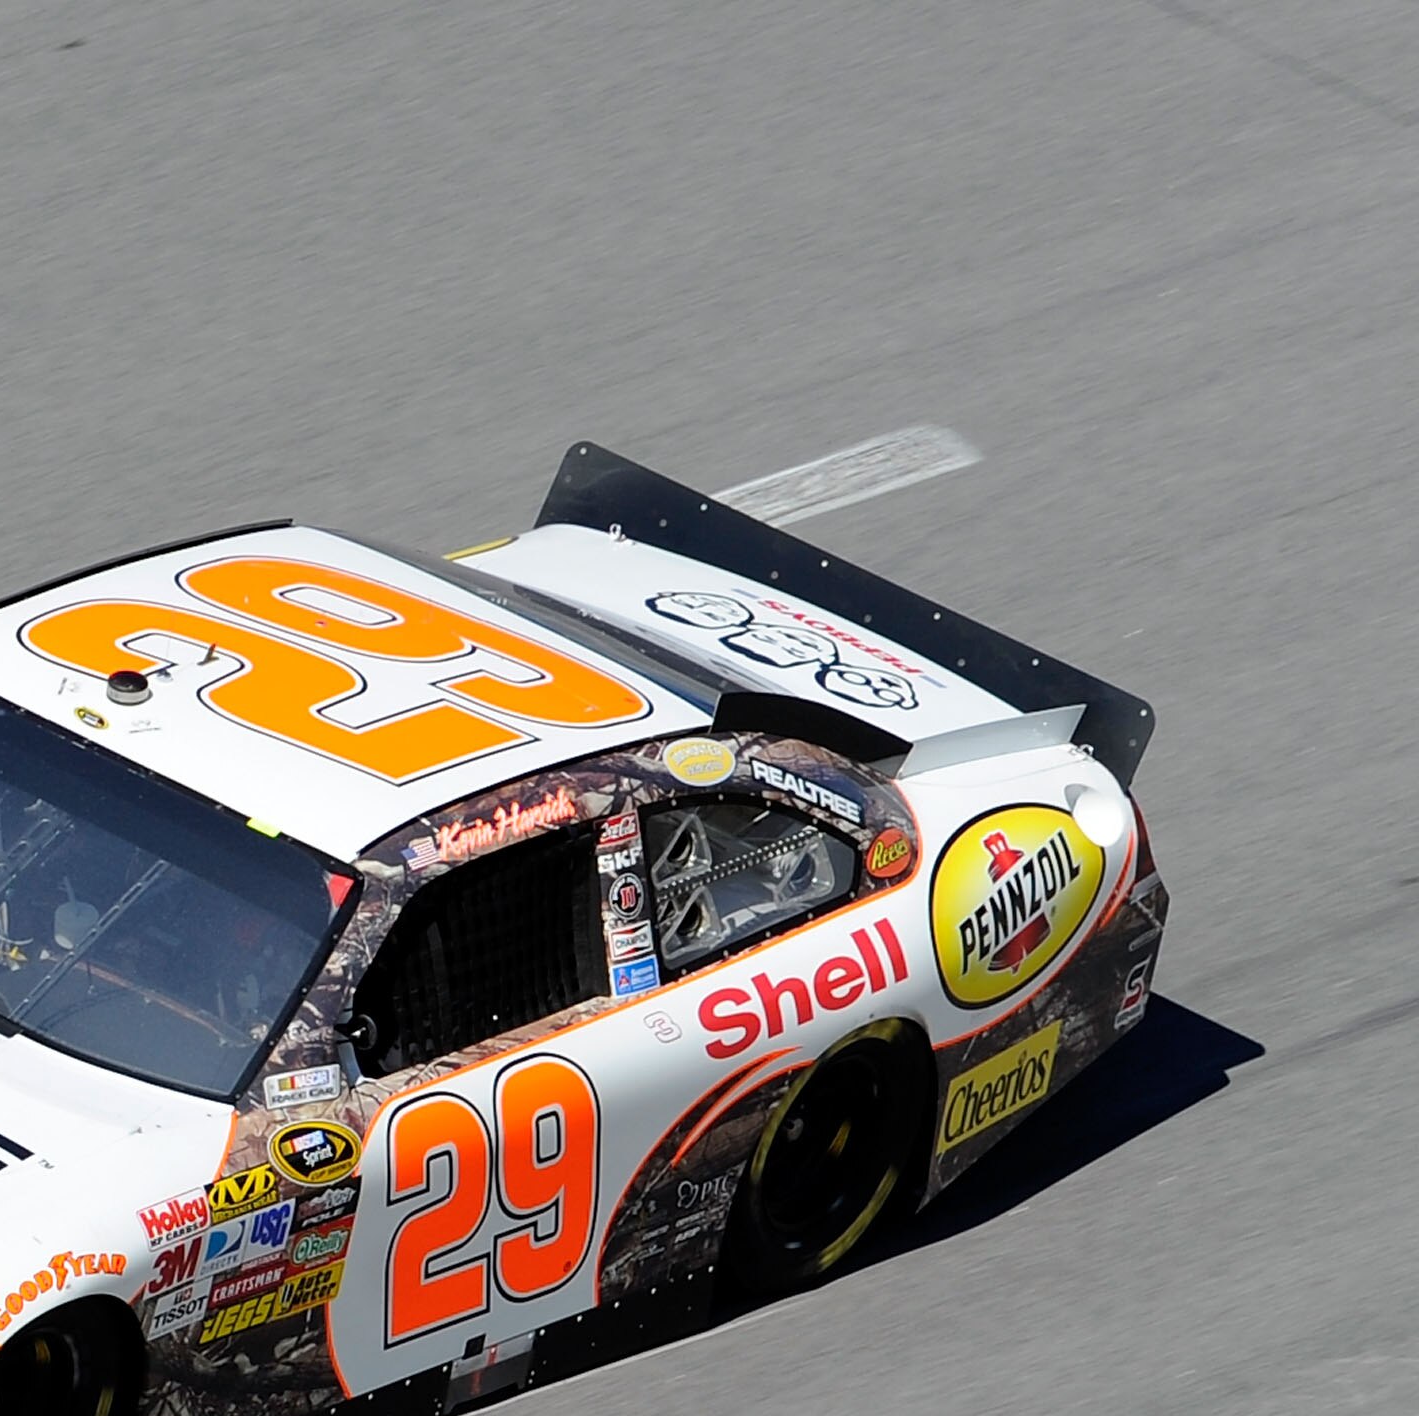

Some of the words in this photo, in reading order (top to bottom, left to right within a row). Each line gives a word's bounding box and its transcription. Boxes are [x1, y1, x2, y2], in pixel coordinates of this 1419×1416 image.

[17, 556, 655, 785] 29
[752, 760, 861, 823] REALTREE
[437, 818, 496, 861] Kevin
[494, 787, 577, 842] Harvick
[597, 848, 643, 873] SKF
[959, 830, 1084, 975] PENNZOIL
[698, 918, 909, 1060] Shell
[643, 1011, 682, 1043] 3
[309, 1086, 334, 1098] CAR
[943, 1049, 1050, 1144] Cheerios
[303, 1144, 334, 1167] Sprint
[140, 1197, 207, 1240] Holley
[250, 1203, 291, 1248] USG
[385, 1053, 601, 1350] 29
[148, 1236, 203, 1294] 3M
[213, 1266, 285, 1302] CRAFTSMAN
[297, 1270, 332, 1292] Auto
[153, 1295, 208, 1329] TISSOT
[199, 1291, 276, 1345] JEGS
